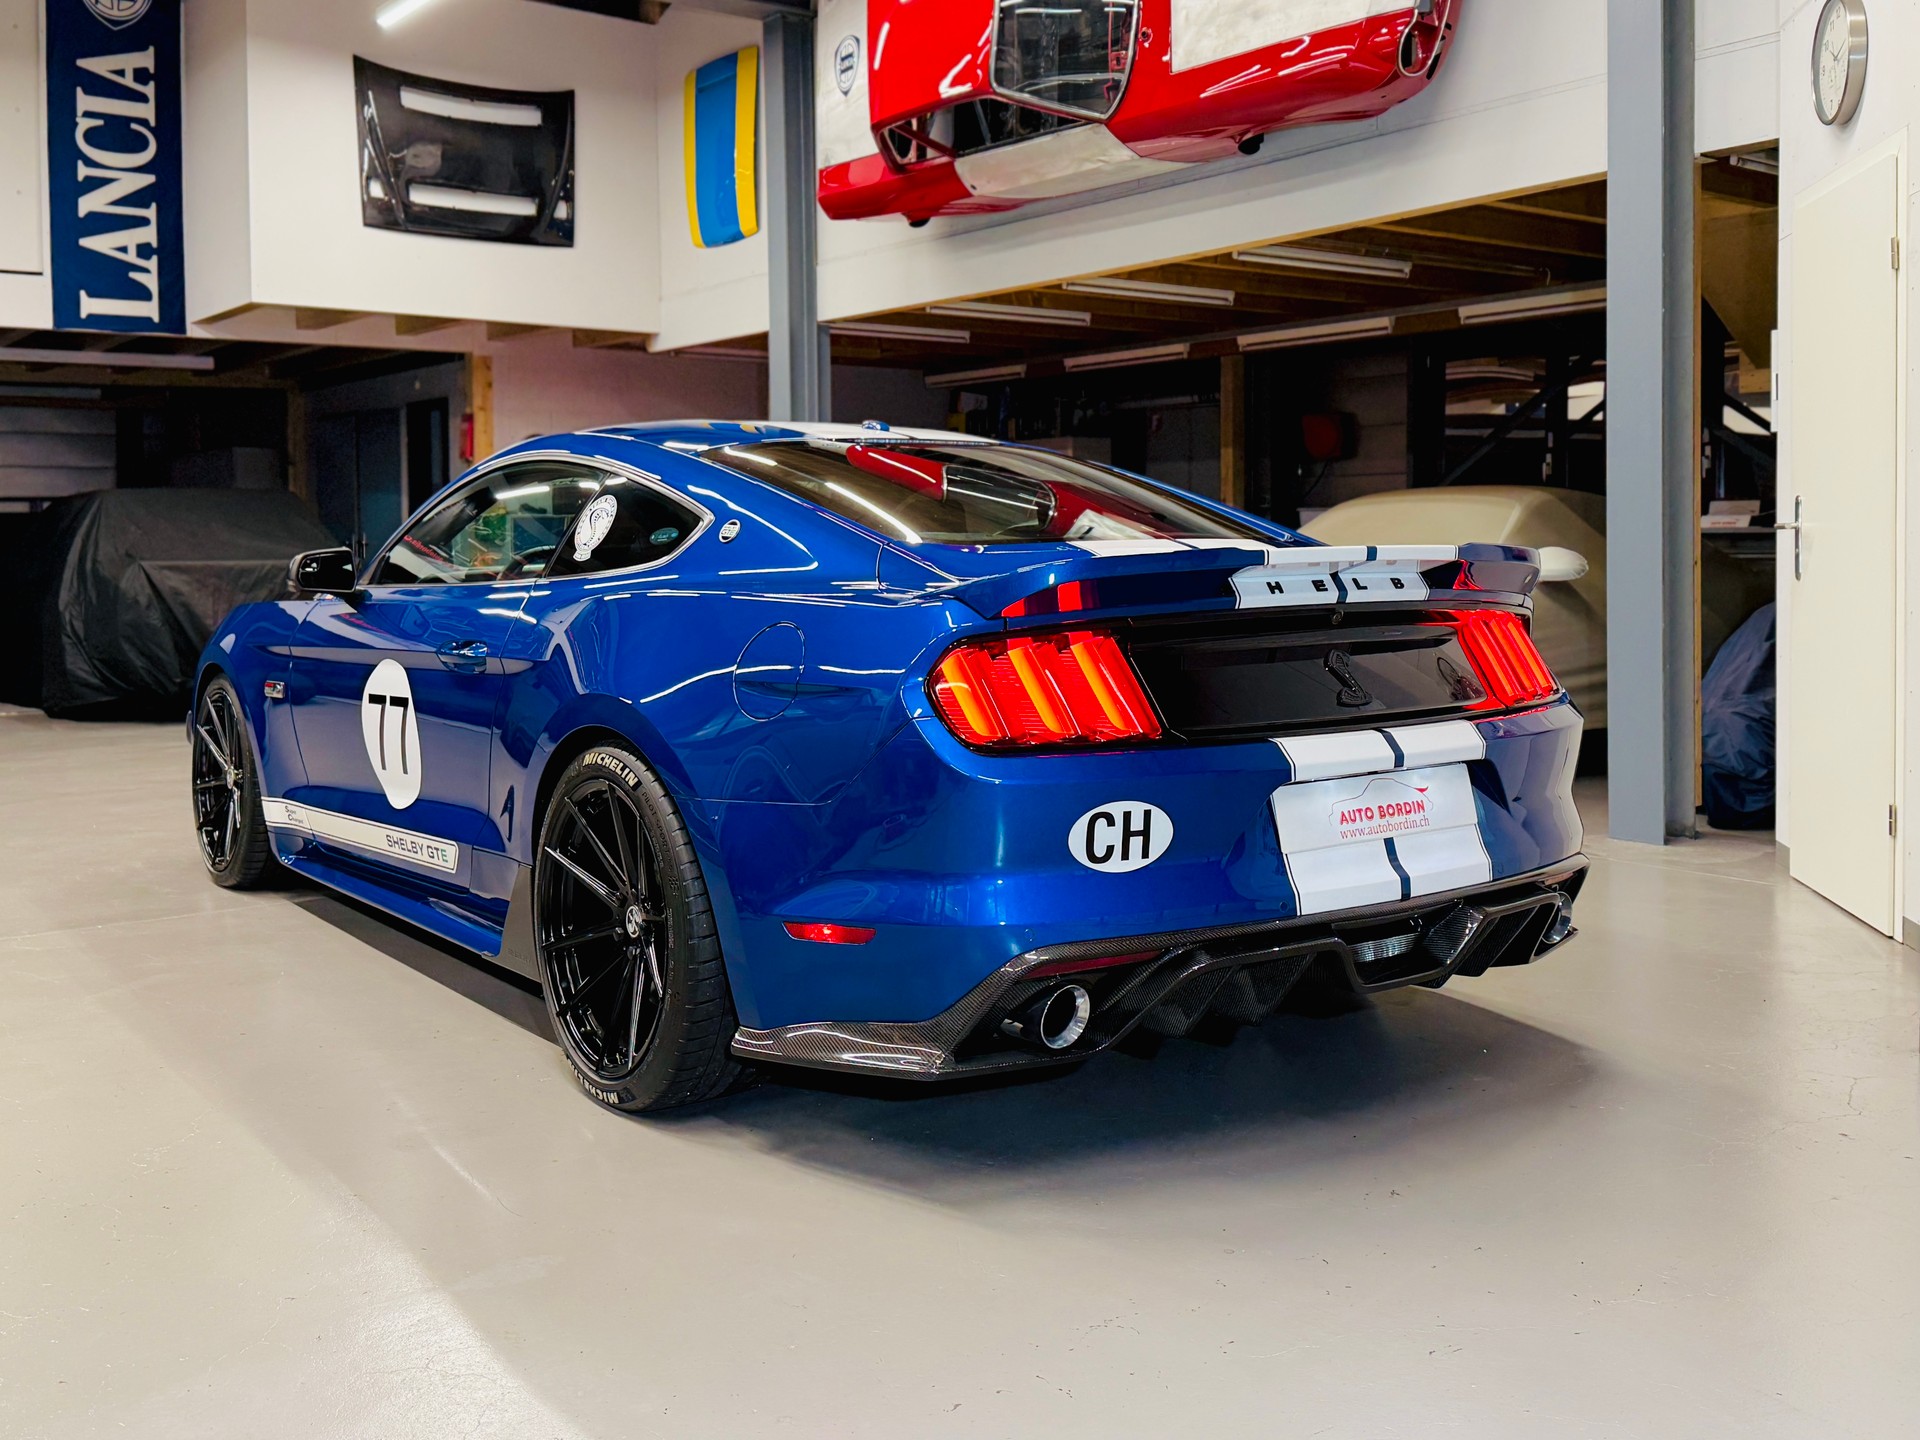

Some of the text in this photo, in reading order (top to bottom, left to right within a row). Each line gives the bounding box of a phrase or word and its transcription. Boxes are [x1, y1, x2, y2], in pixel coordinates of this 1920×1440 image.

[75, 45, 159, 323] LANCIA
[368, 693, 409, 775] 77
[582, 752, 639, 788] MICHELIN
[1339, 800, 1426, 826] AUTO BORDIN
[1340, 814, 1430, 839] www.autobordin.ch
[385, 834, 449, 864] SHELBY GTE
[1086, 809, 1152, 865] CH
